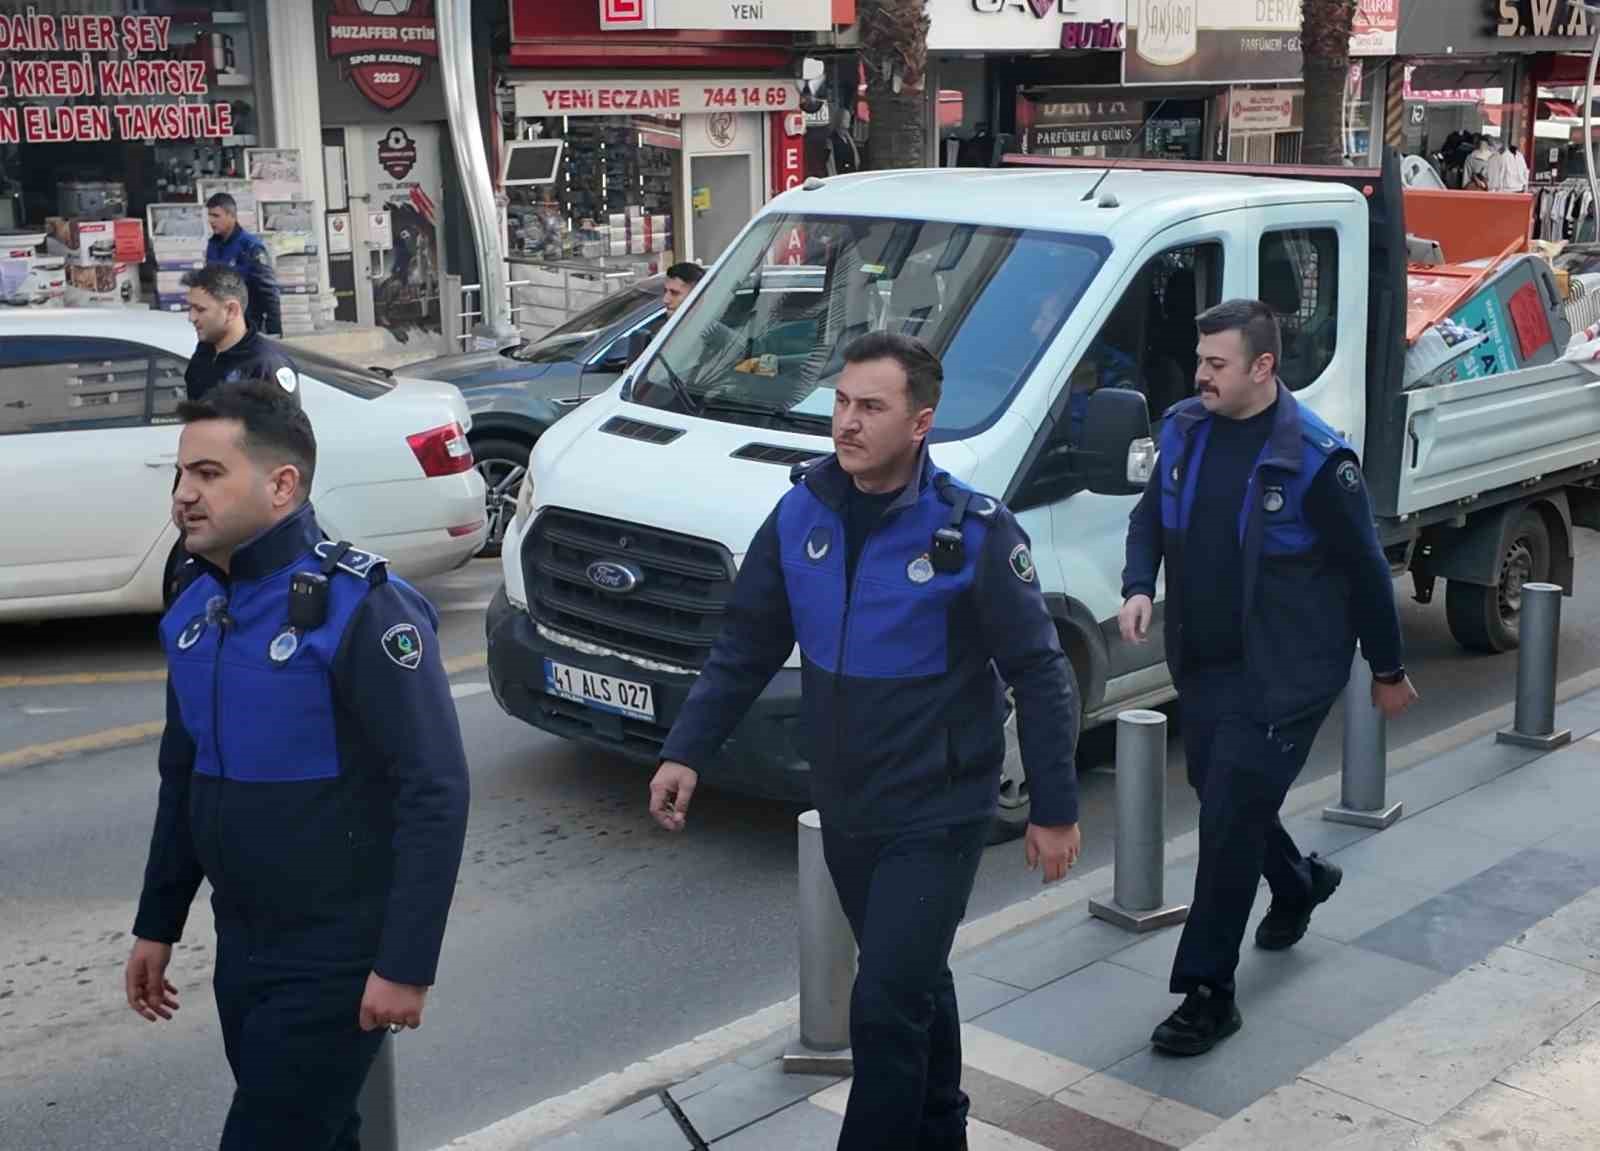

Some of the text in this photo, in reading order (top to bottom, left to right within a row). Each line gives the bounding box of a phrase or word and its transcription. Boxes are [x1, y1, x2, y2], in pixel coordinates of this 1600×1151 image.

[731, 3, 763, 20] YENİ
[1255, 0, 1302, 22] DERY
[0, 6, 171, 60] DAİR HER ŞEY
[331, 25, 435, 42] MUZAFFER ÇETİN
[349, 54, 377, 65] SPOR
[13, 52, 94, 97] KREDİ
[99, 60, 208, 96] KARTSIZ
[373, 72, 401, 84] 2023
[543, 88, 680, 110] YENİ ECZANE
[703, 87, 786, 107] 744 14 69
[25, 105, 112, 142] ELDEN
[114, 96, 234, 141] TAKSİTLE
[1036, 128, 1091, 145] PARFÜMERİ
[593, 566, 622, 586] Ford
[554, 666, 572, 692] 41
[583, 673, 612, 702] ALS
[618, 682, 649, 710] 027
